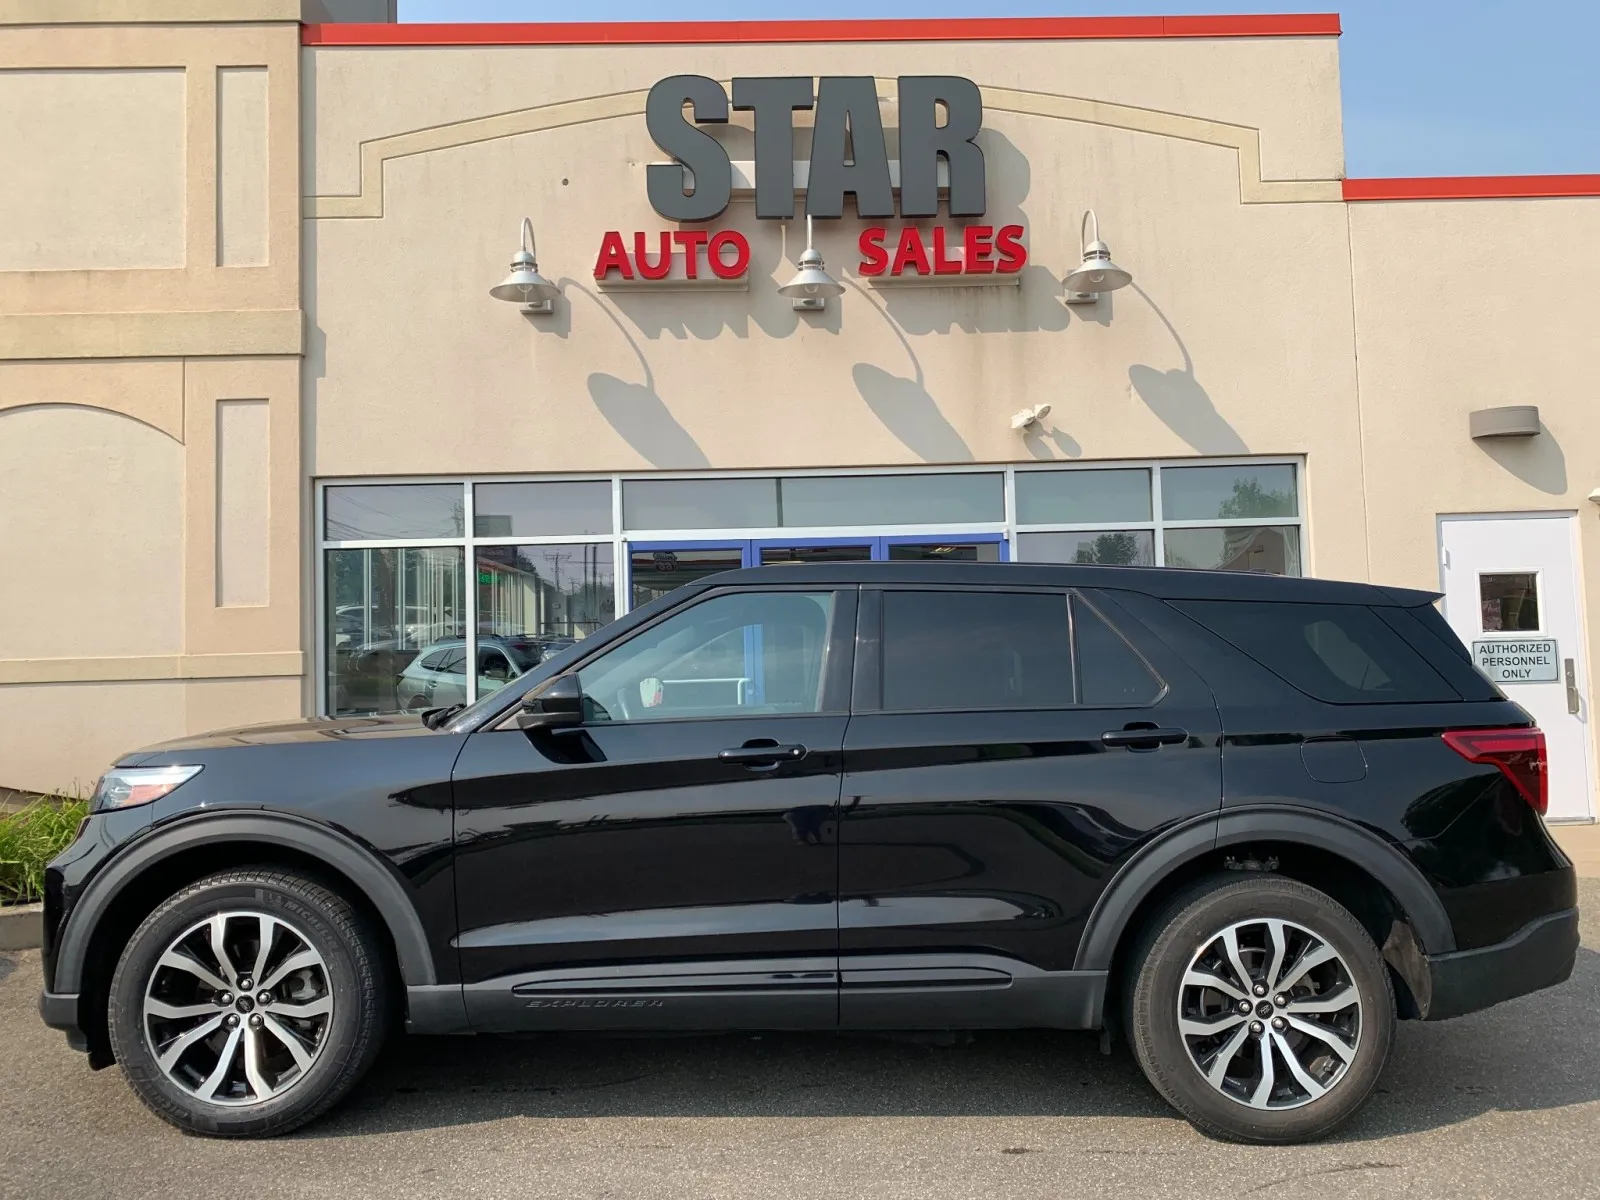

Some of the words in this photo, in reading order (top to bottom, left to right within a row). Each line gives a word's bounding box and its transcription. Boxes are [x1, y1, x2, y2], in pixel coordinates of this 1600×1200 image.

[646, 75, 986, 222] STAR
[593, 230, 750, 280] AUTO
[858, 225, 1028, 277] SALES
[1479, 643, 1551, 654] AUTHORIZED
[1482, 656, 1550, 667] PERSONNEL
[1502, 669, 1531, 679] ONLY
[525, 1000, 664, 1008] EXPLORER
